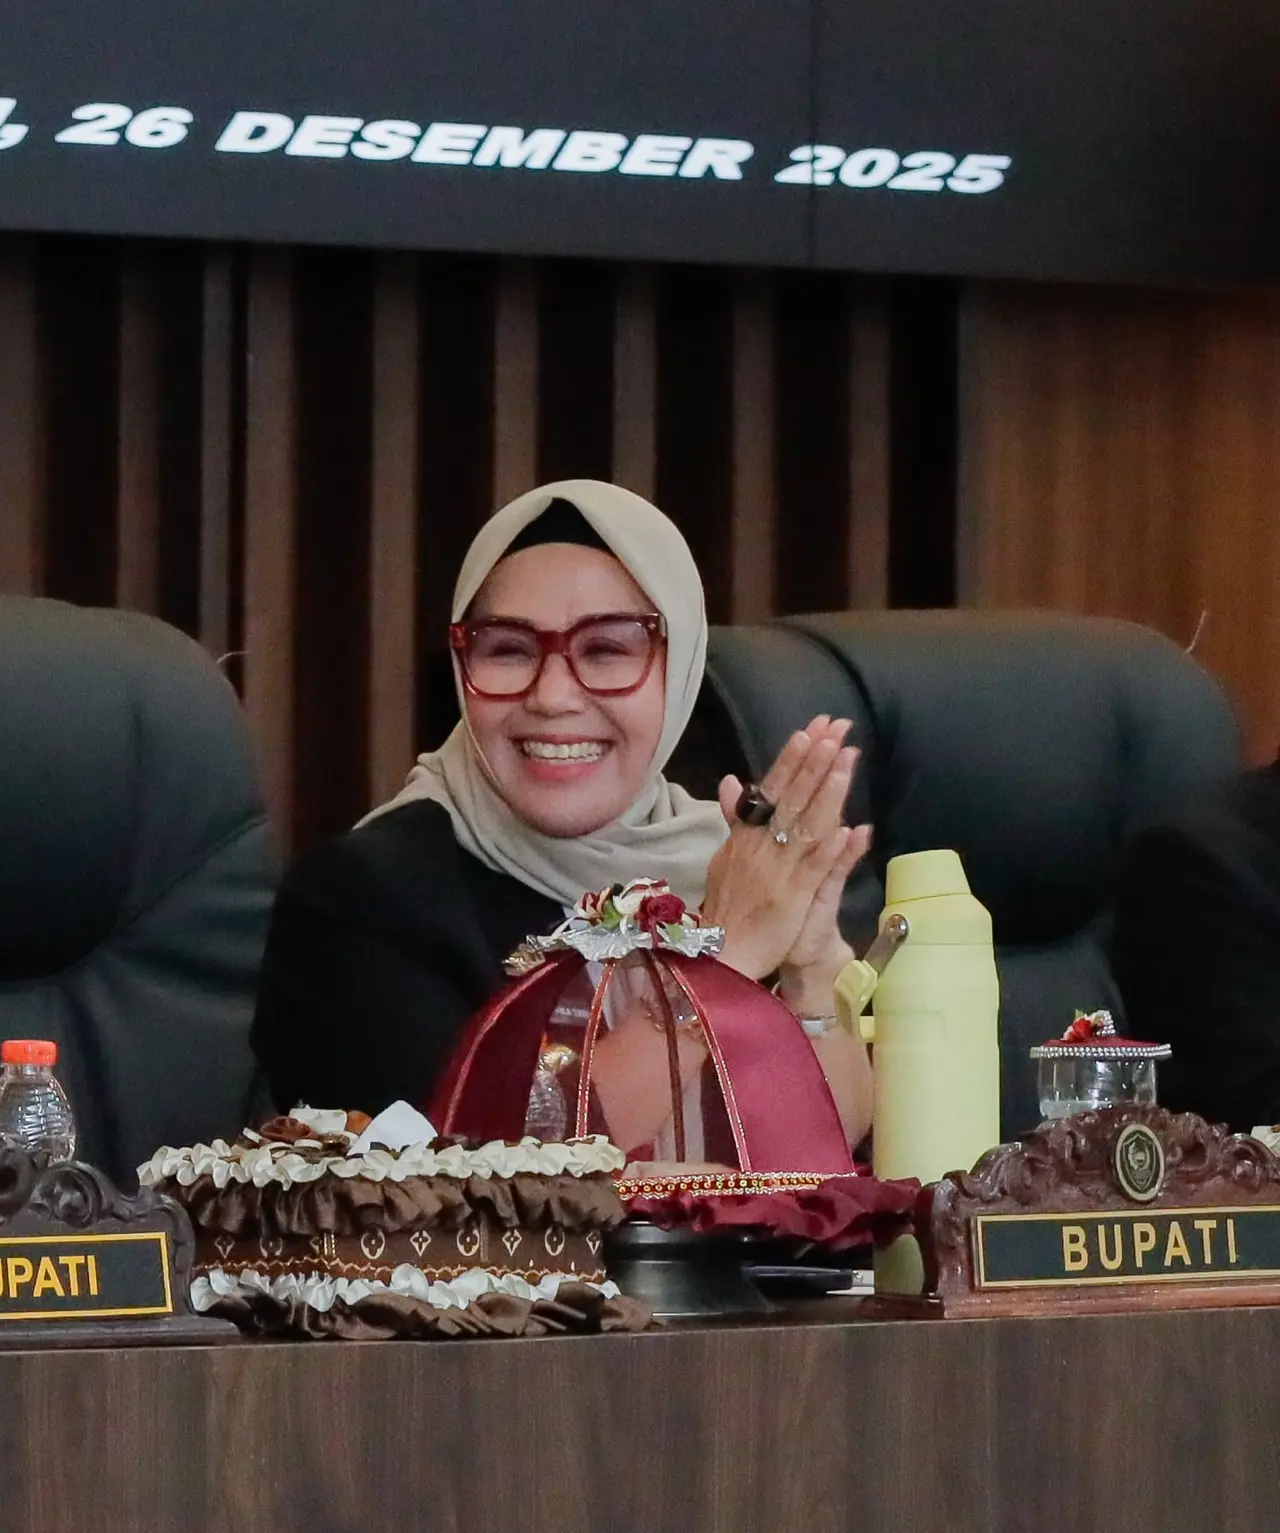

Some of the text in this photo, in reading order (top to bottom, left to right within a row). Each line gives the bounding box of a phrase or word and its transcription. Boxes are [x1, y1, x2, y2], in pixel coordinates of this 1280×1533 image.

[54, 103, 194, 149] 26
[215, 111, 754, 181] DESEMBER
[774, 144, 1012, 194] 2025
[1062, 1218, 1237, 1271] BUPATI
